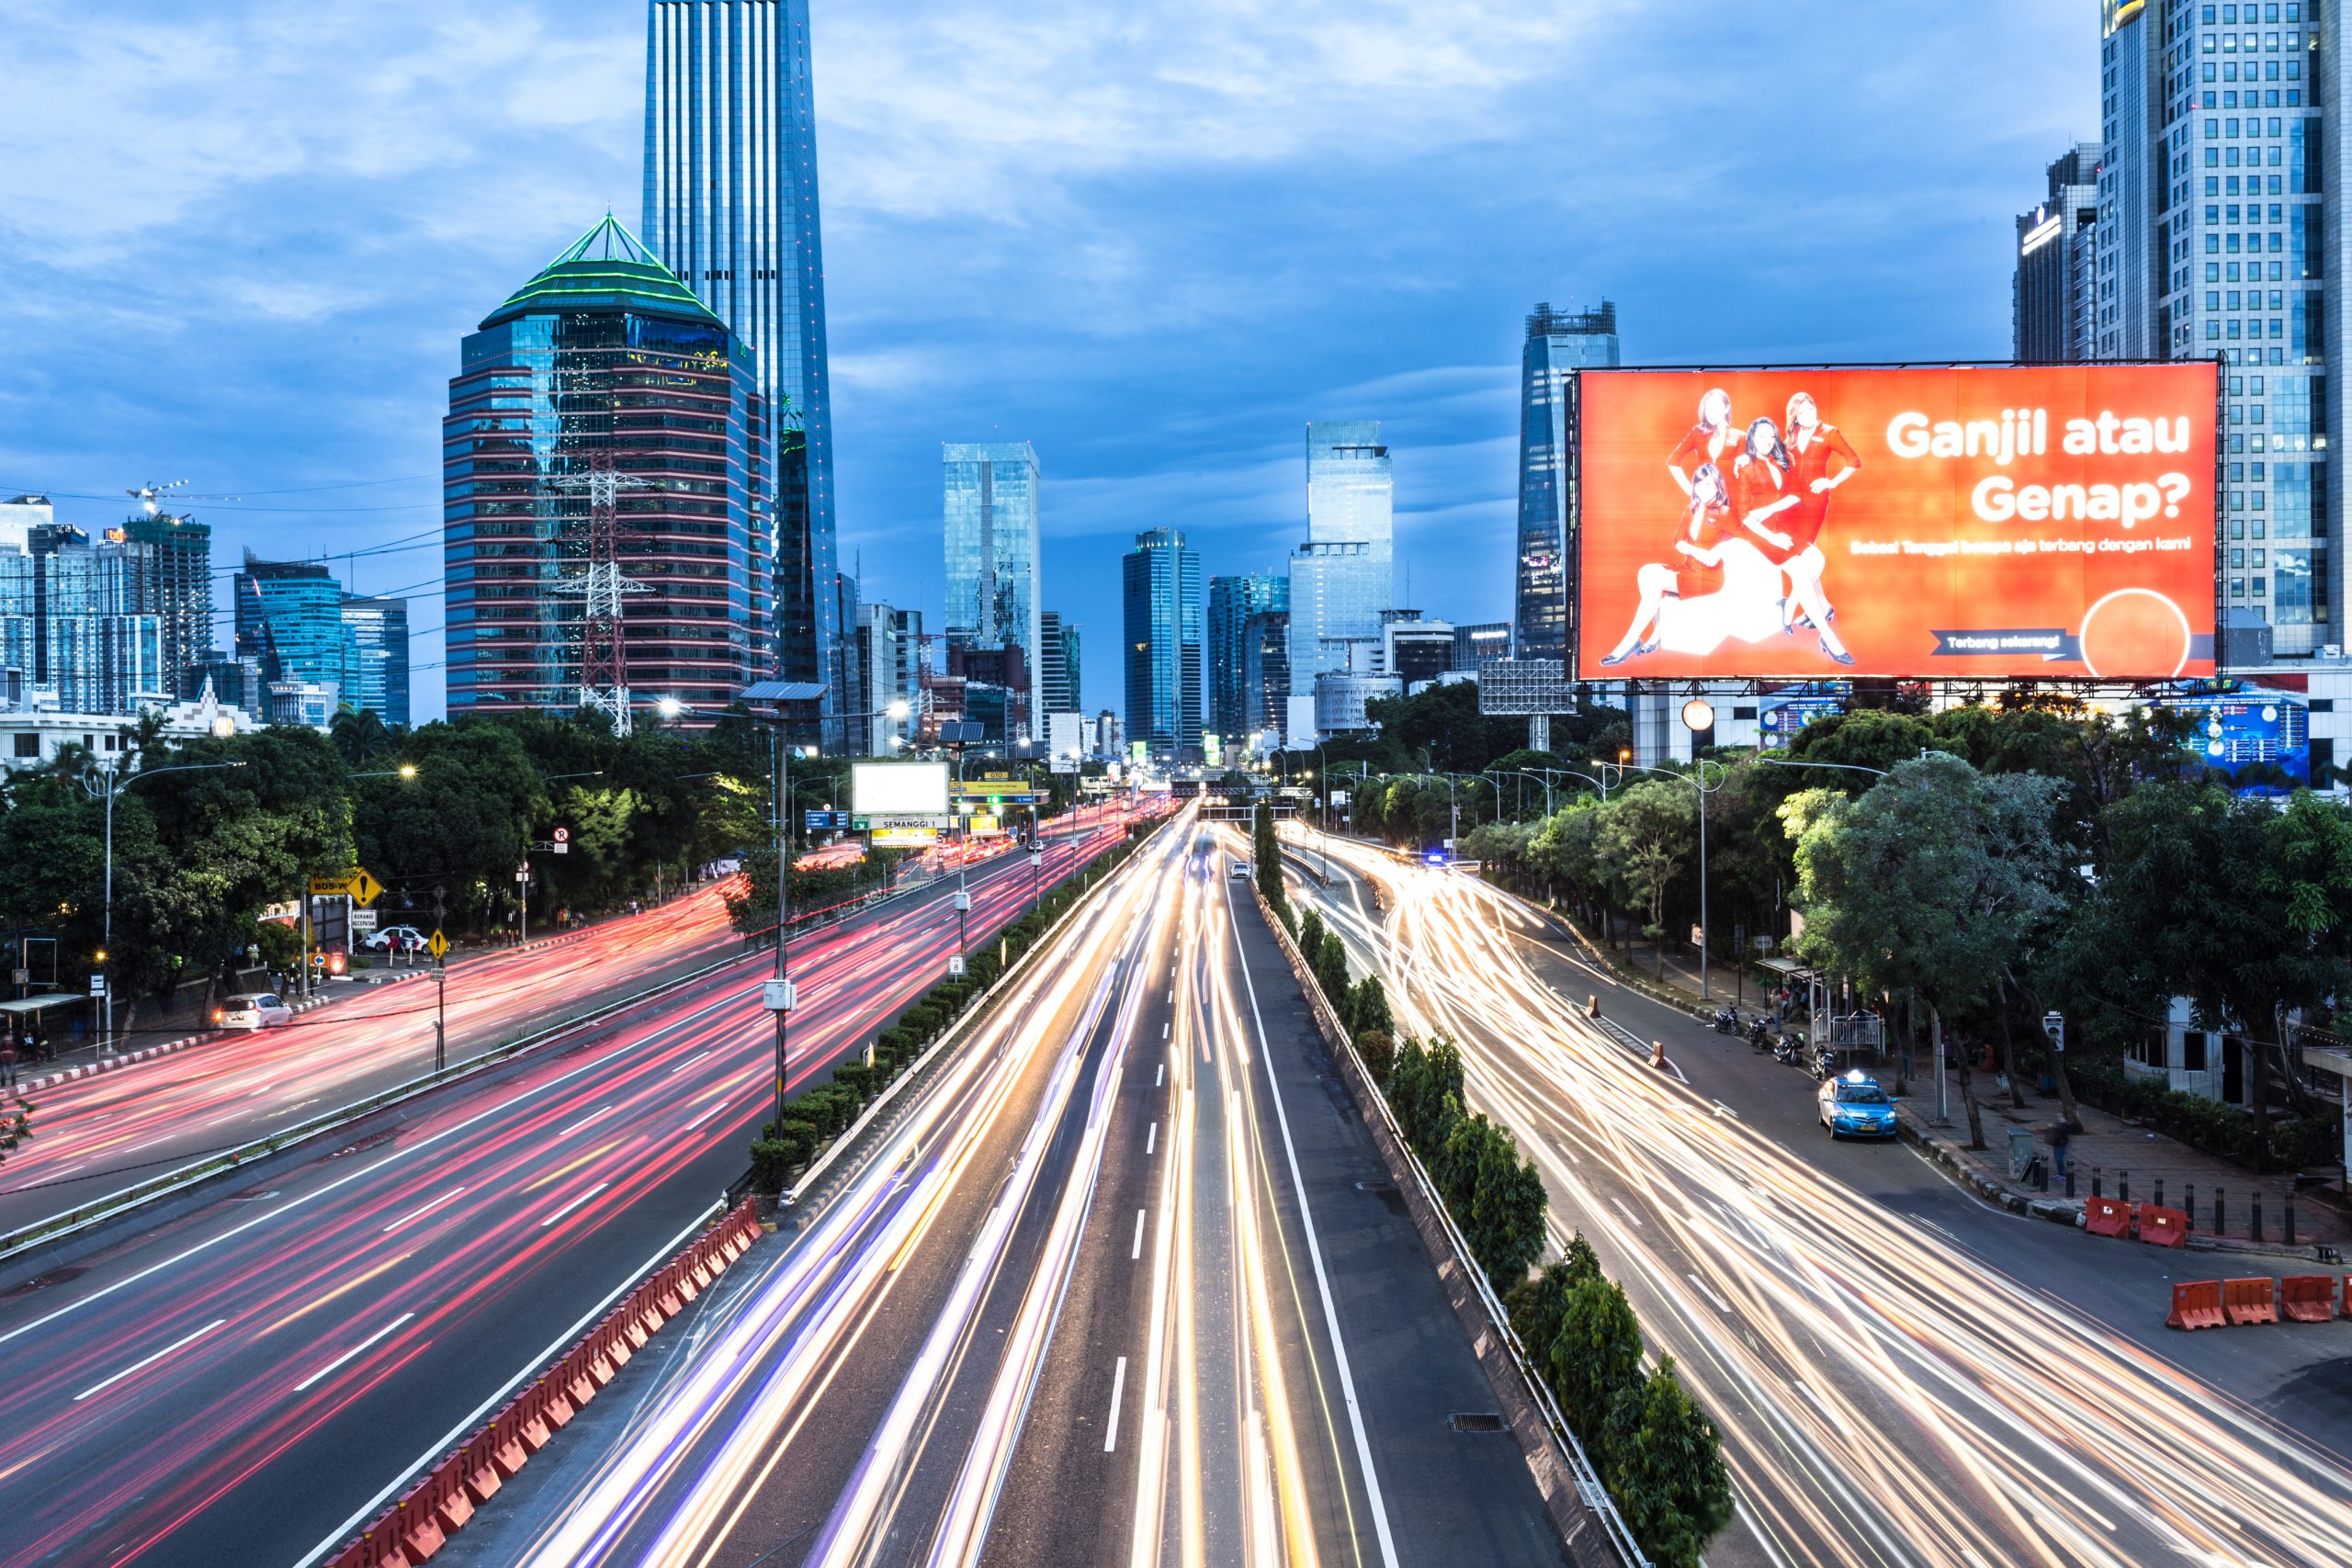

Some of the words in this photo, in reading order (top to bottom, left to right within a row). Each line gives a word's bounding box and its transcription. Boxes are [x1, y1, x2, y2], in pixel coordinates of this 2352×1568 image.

[1886, 408, 2047, 466] Ganjil
[2063, 410, 2189, 455] atau
[1972, 472, 2191, 529] Genap?
[1902, 540, 1959, 556] Tanggal
[2039, 538, 2096, 554] terbang
[2098, 537, 2153, 553] dengan
[2155, 536, 2191, 550] kami
[1948, 636, 1999, 649] Terbang
[2000, 635, 2060, 649] sekarang!
